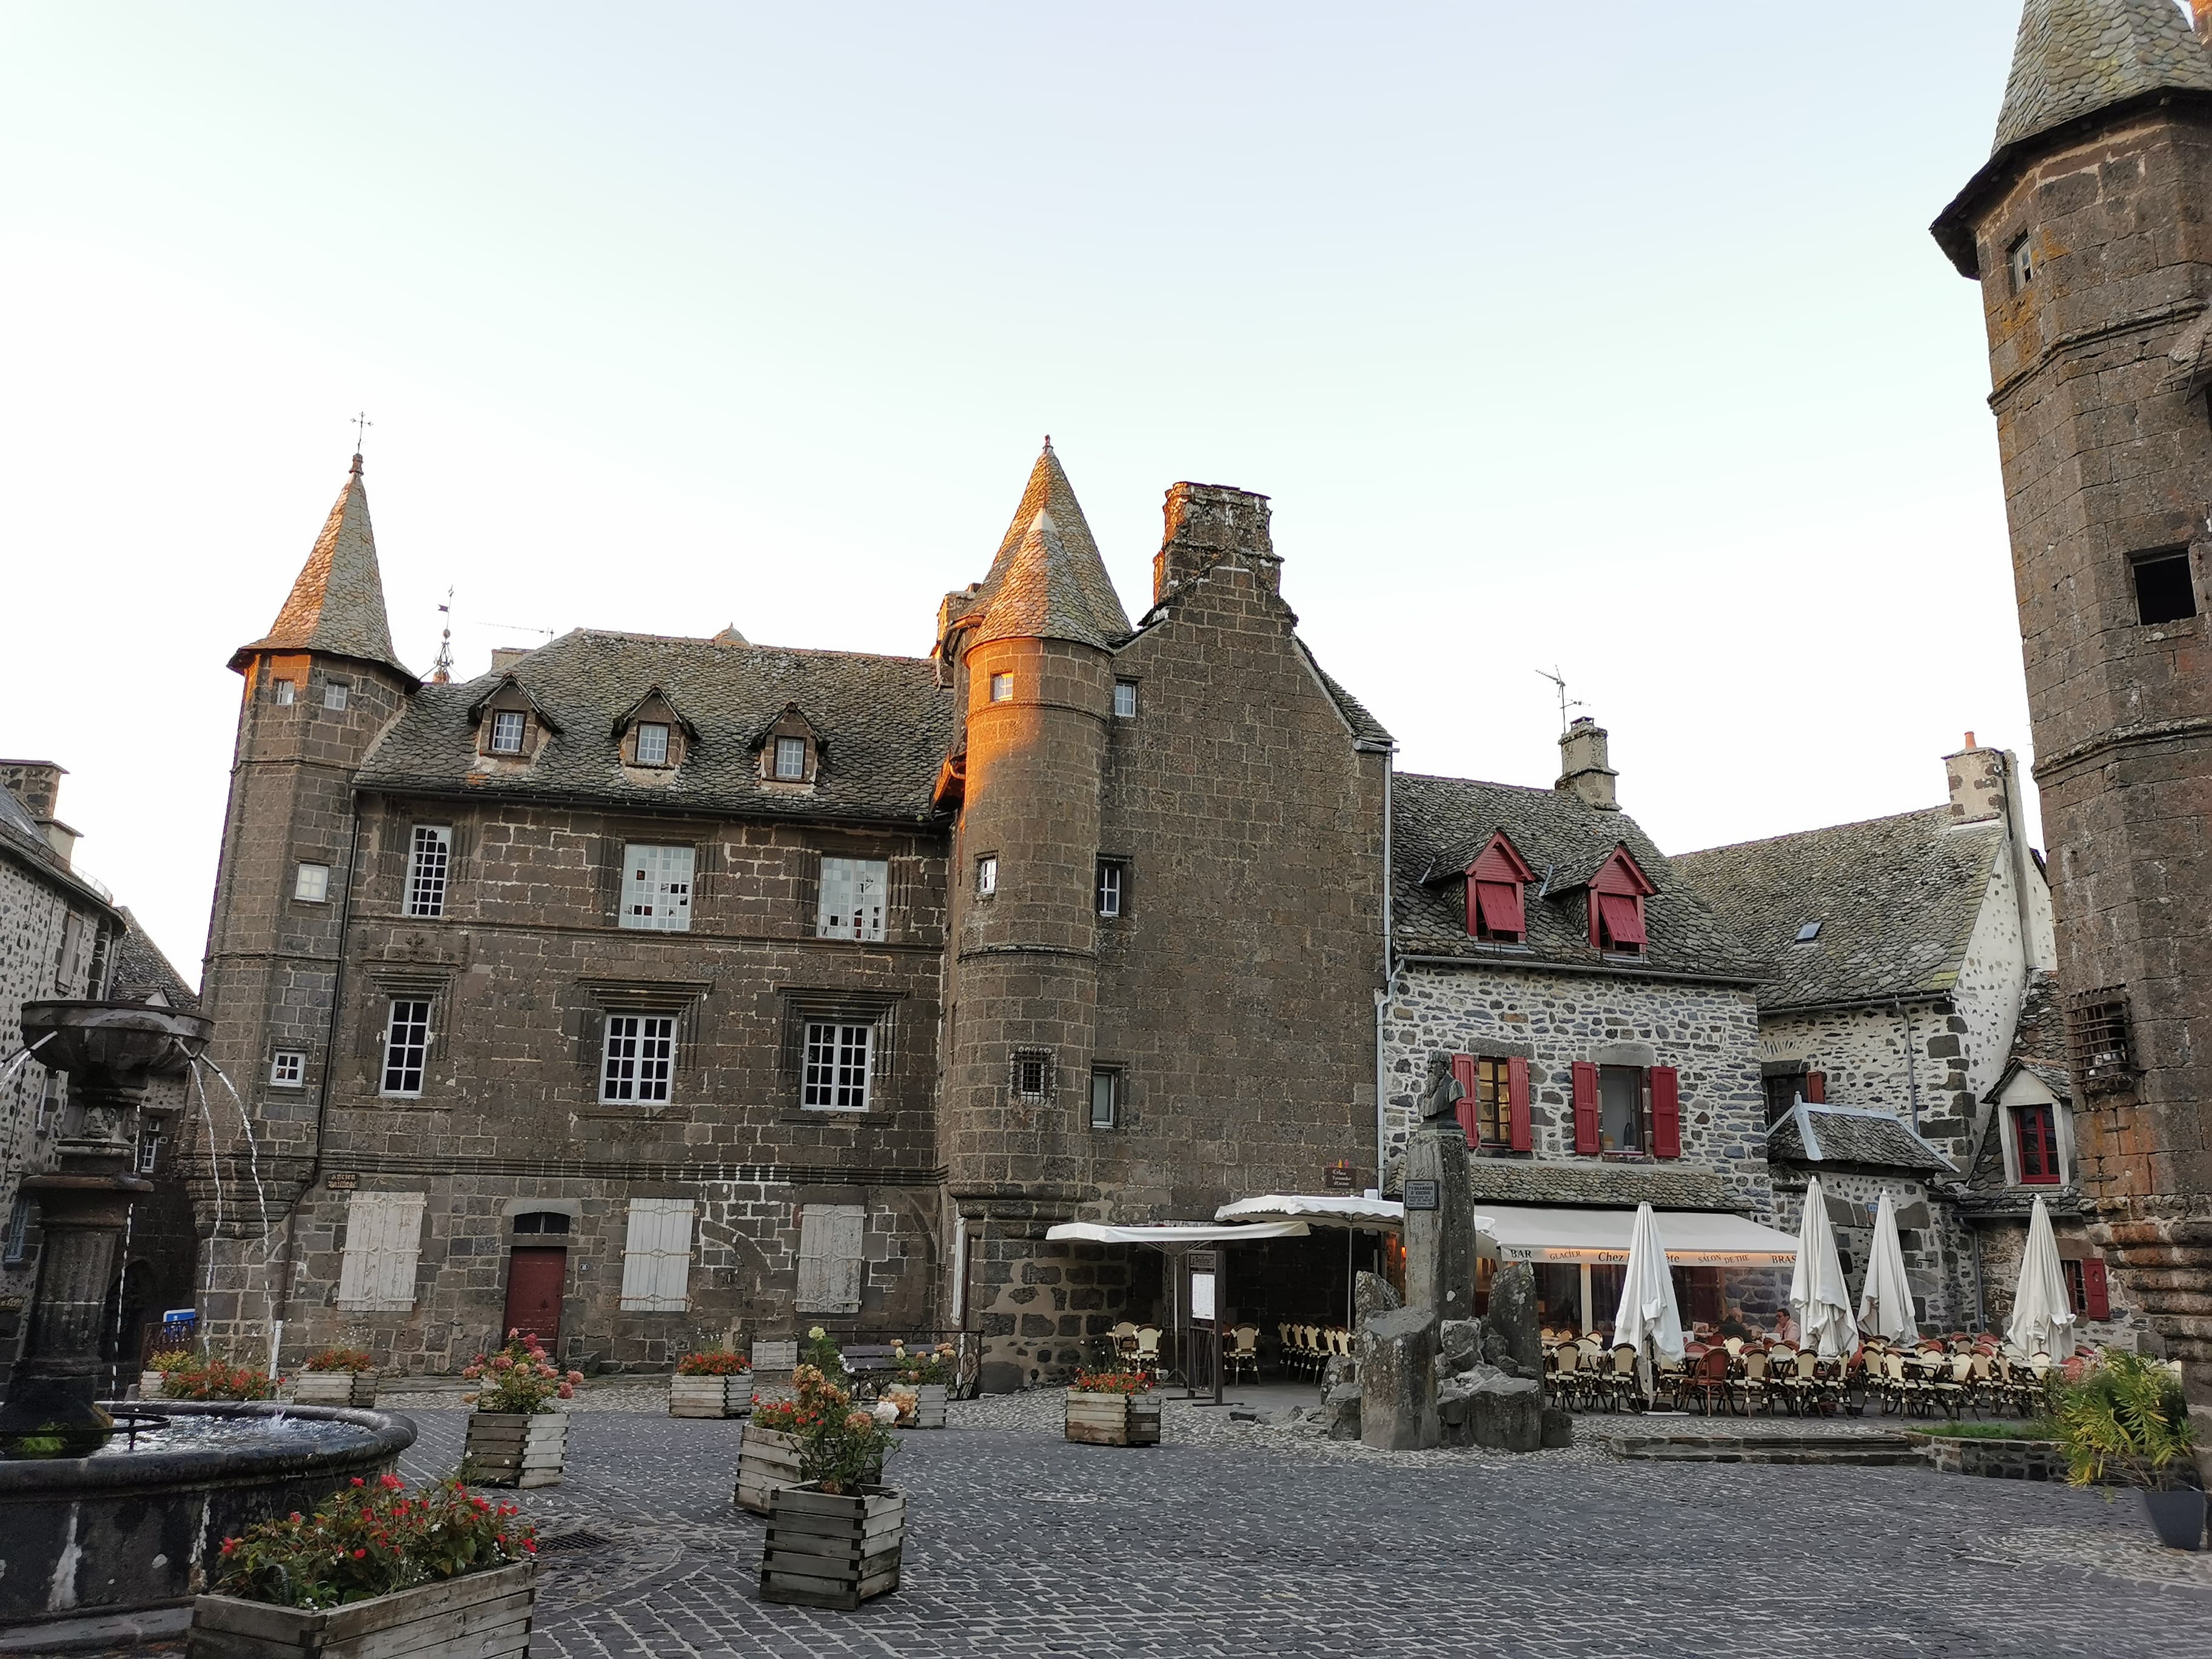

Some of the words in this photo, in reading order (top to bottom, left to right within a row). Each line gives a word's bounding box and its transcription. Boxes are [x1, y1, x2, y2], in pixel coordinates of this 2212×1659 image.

[1510, 1249, 1532, 1258] BAR
[1549, 1250, 1581, 1260] GLACIER
[1598, 1252, 1624, 1262] Chez
[1698, 1253, 1721, 1263] SALON
